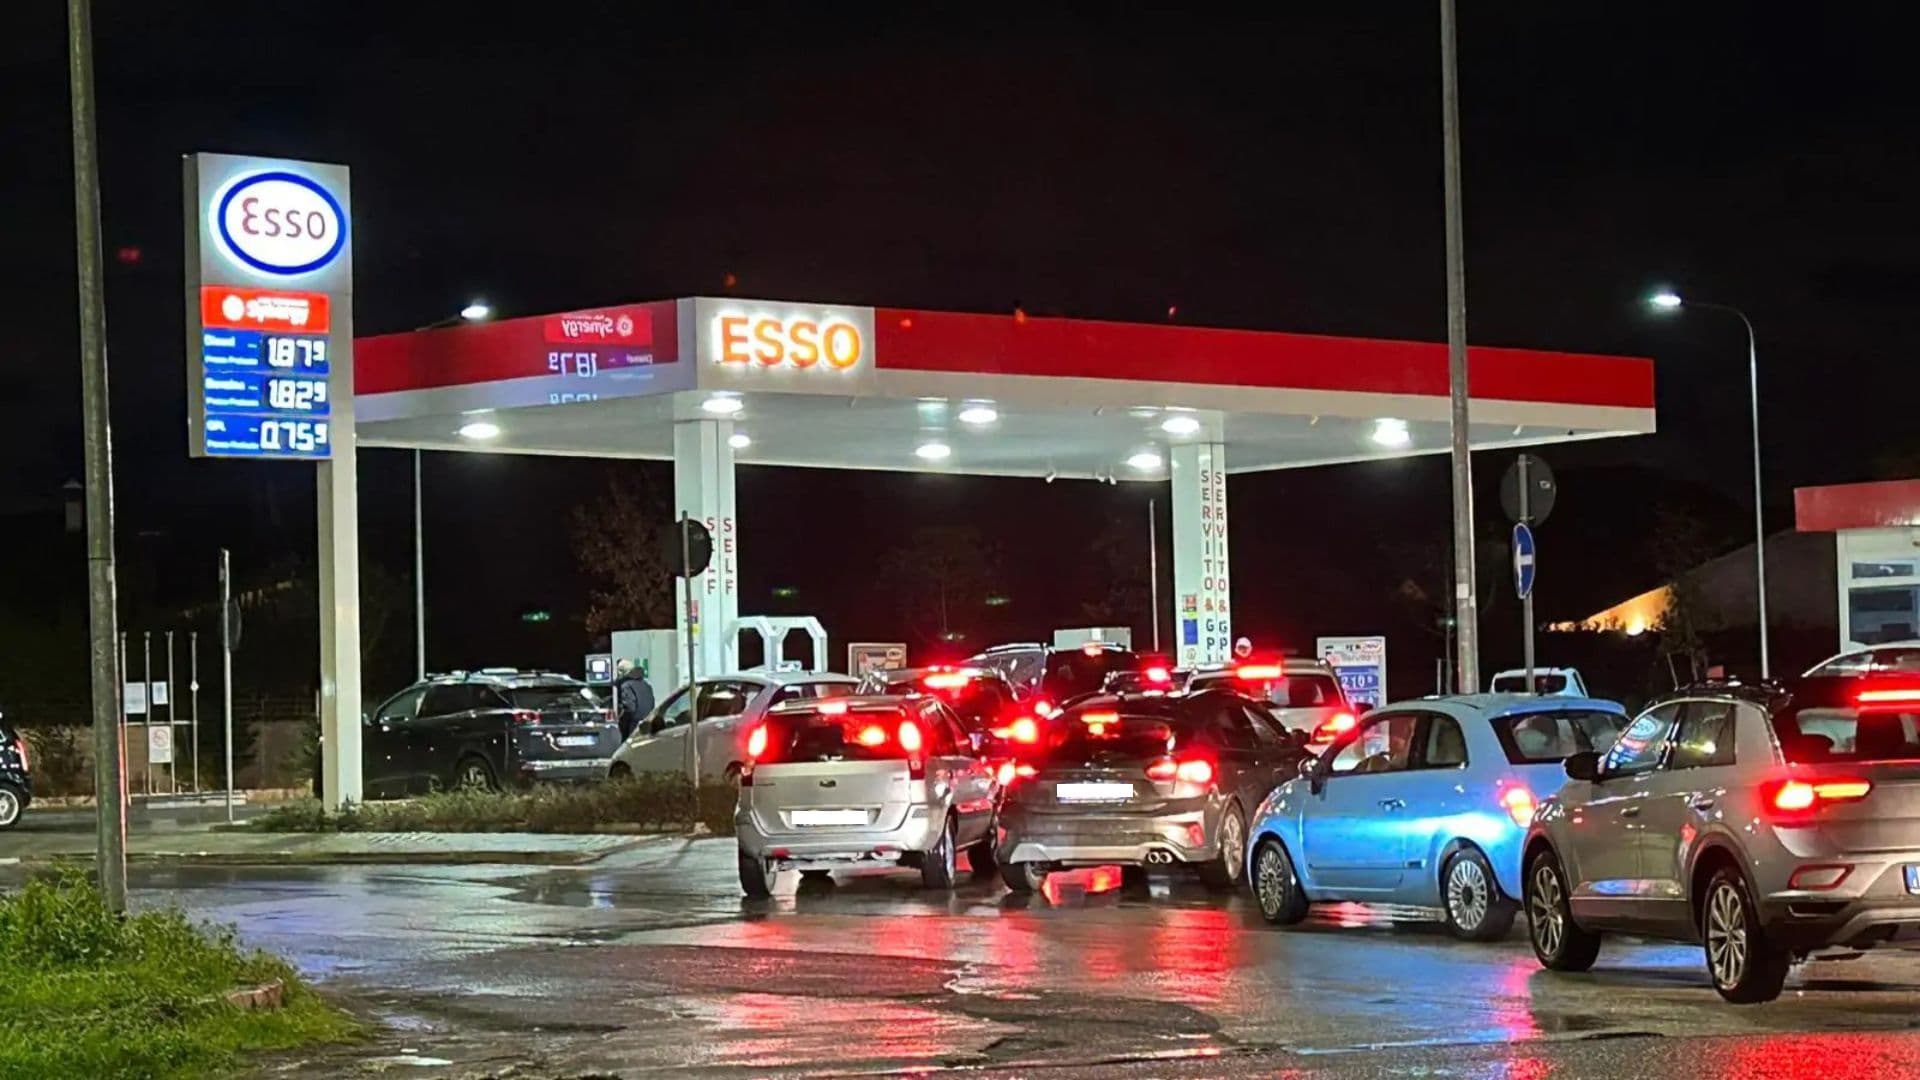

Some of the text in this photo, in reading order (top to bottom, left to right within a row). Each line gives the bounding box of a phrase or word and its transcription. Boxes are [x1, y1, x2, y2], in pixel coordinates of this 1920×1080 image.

[721, 316, 860, 368] ESSO
[723, 518, 733, 595] SELF
[1201, 470, 1214, 591] SERVITO
[1215, 472, 1226, 592] SERVITO
